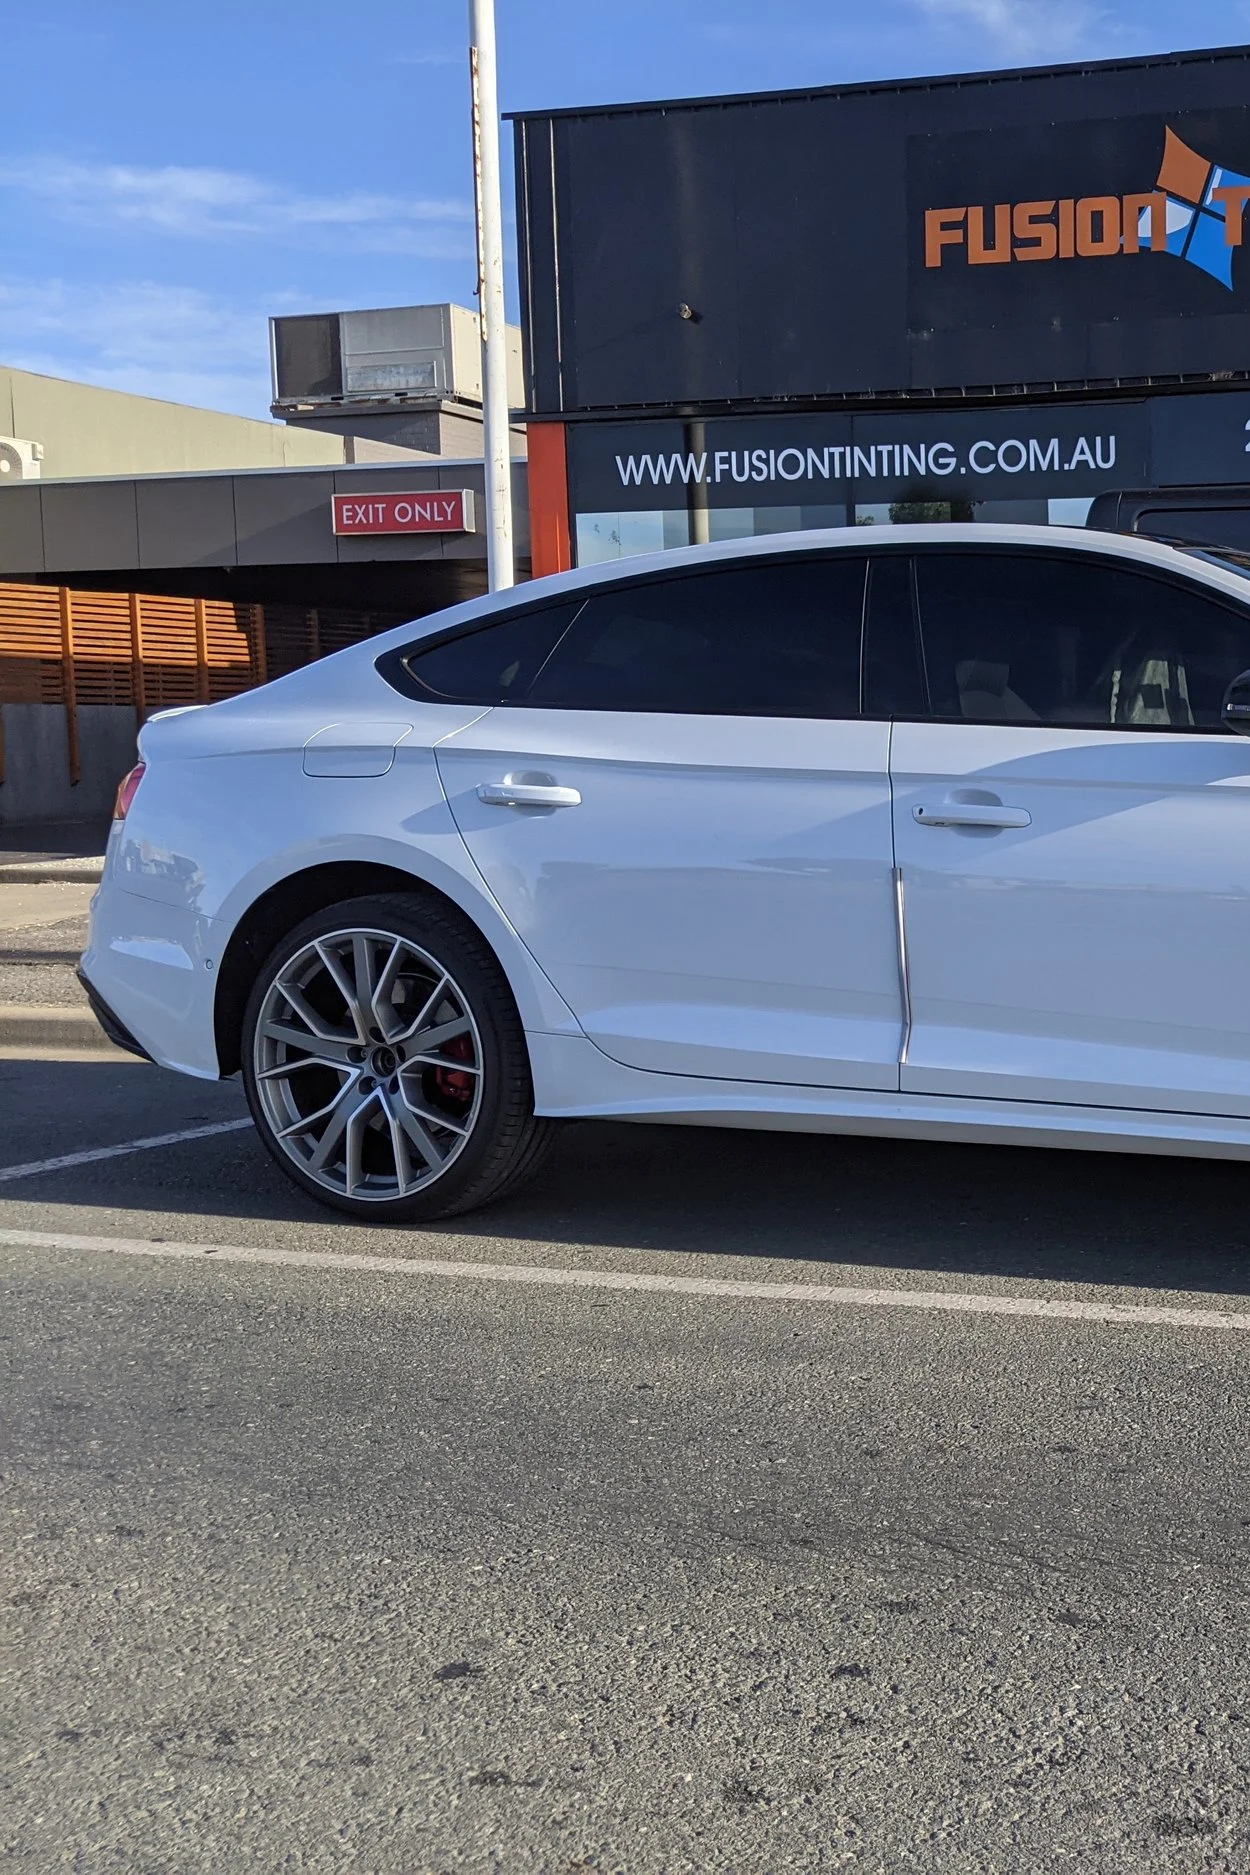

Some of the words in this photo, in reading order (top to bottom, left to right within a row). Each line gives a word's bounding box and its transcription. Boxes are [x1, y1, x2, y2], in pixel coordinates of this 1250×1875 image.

[925, 191, 1167, 268] FUSION
[615, 435, 1117, 486] WWW.FUSIONTINTING.COM.AU
[342, 503, 386, 525] EXIT
[394, 501, 456, 523] ONLY
